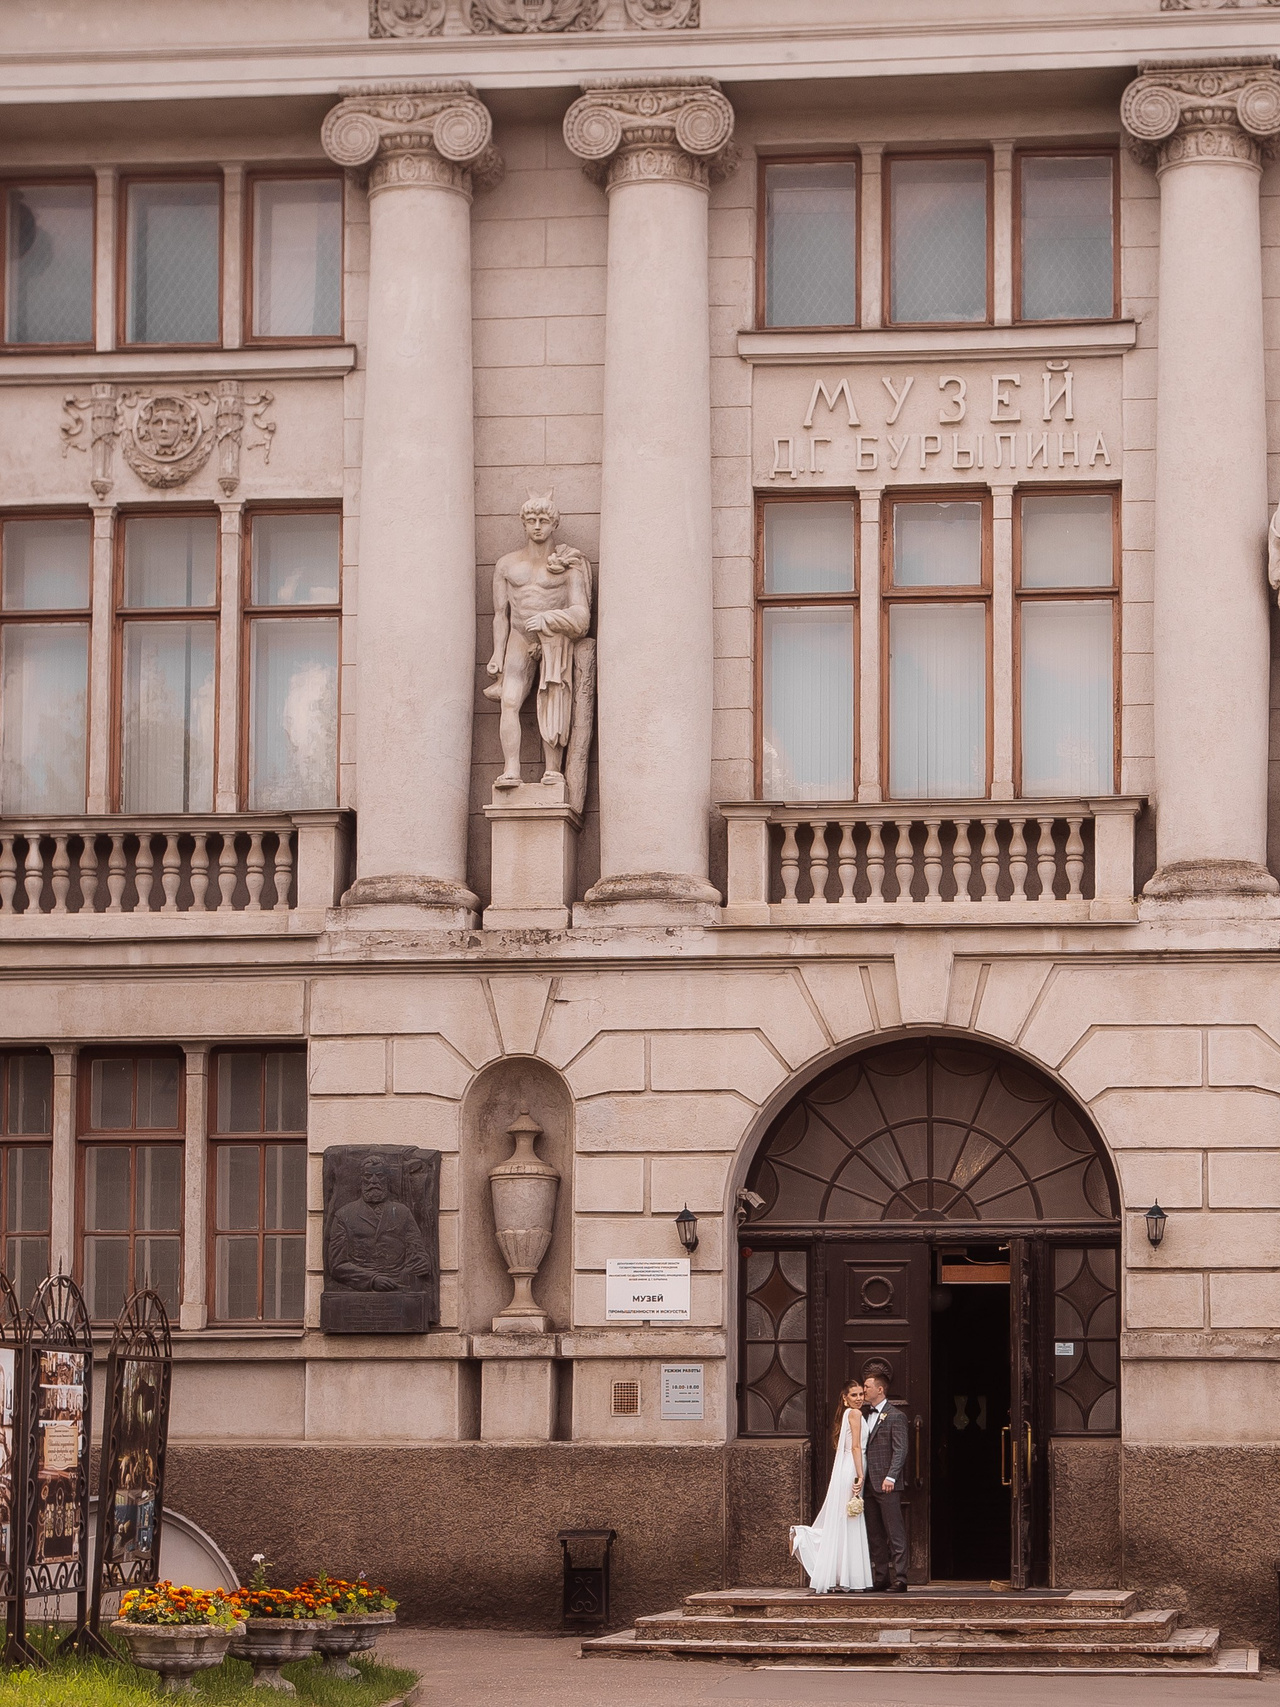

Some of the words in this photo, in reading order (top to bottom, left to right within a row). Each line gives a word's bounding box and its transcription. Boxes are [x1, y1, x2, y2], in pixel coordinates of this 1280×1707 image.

[803, 360, 1074, 428] МУЗЕЙ
[855, 430, 1112, 472] БУРЫЛИНА
[632, 1294, 664, 1302] МУЗЕЙ
